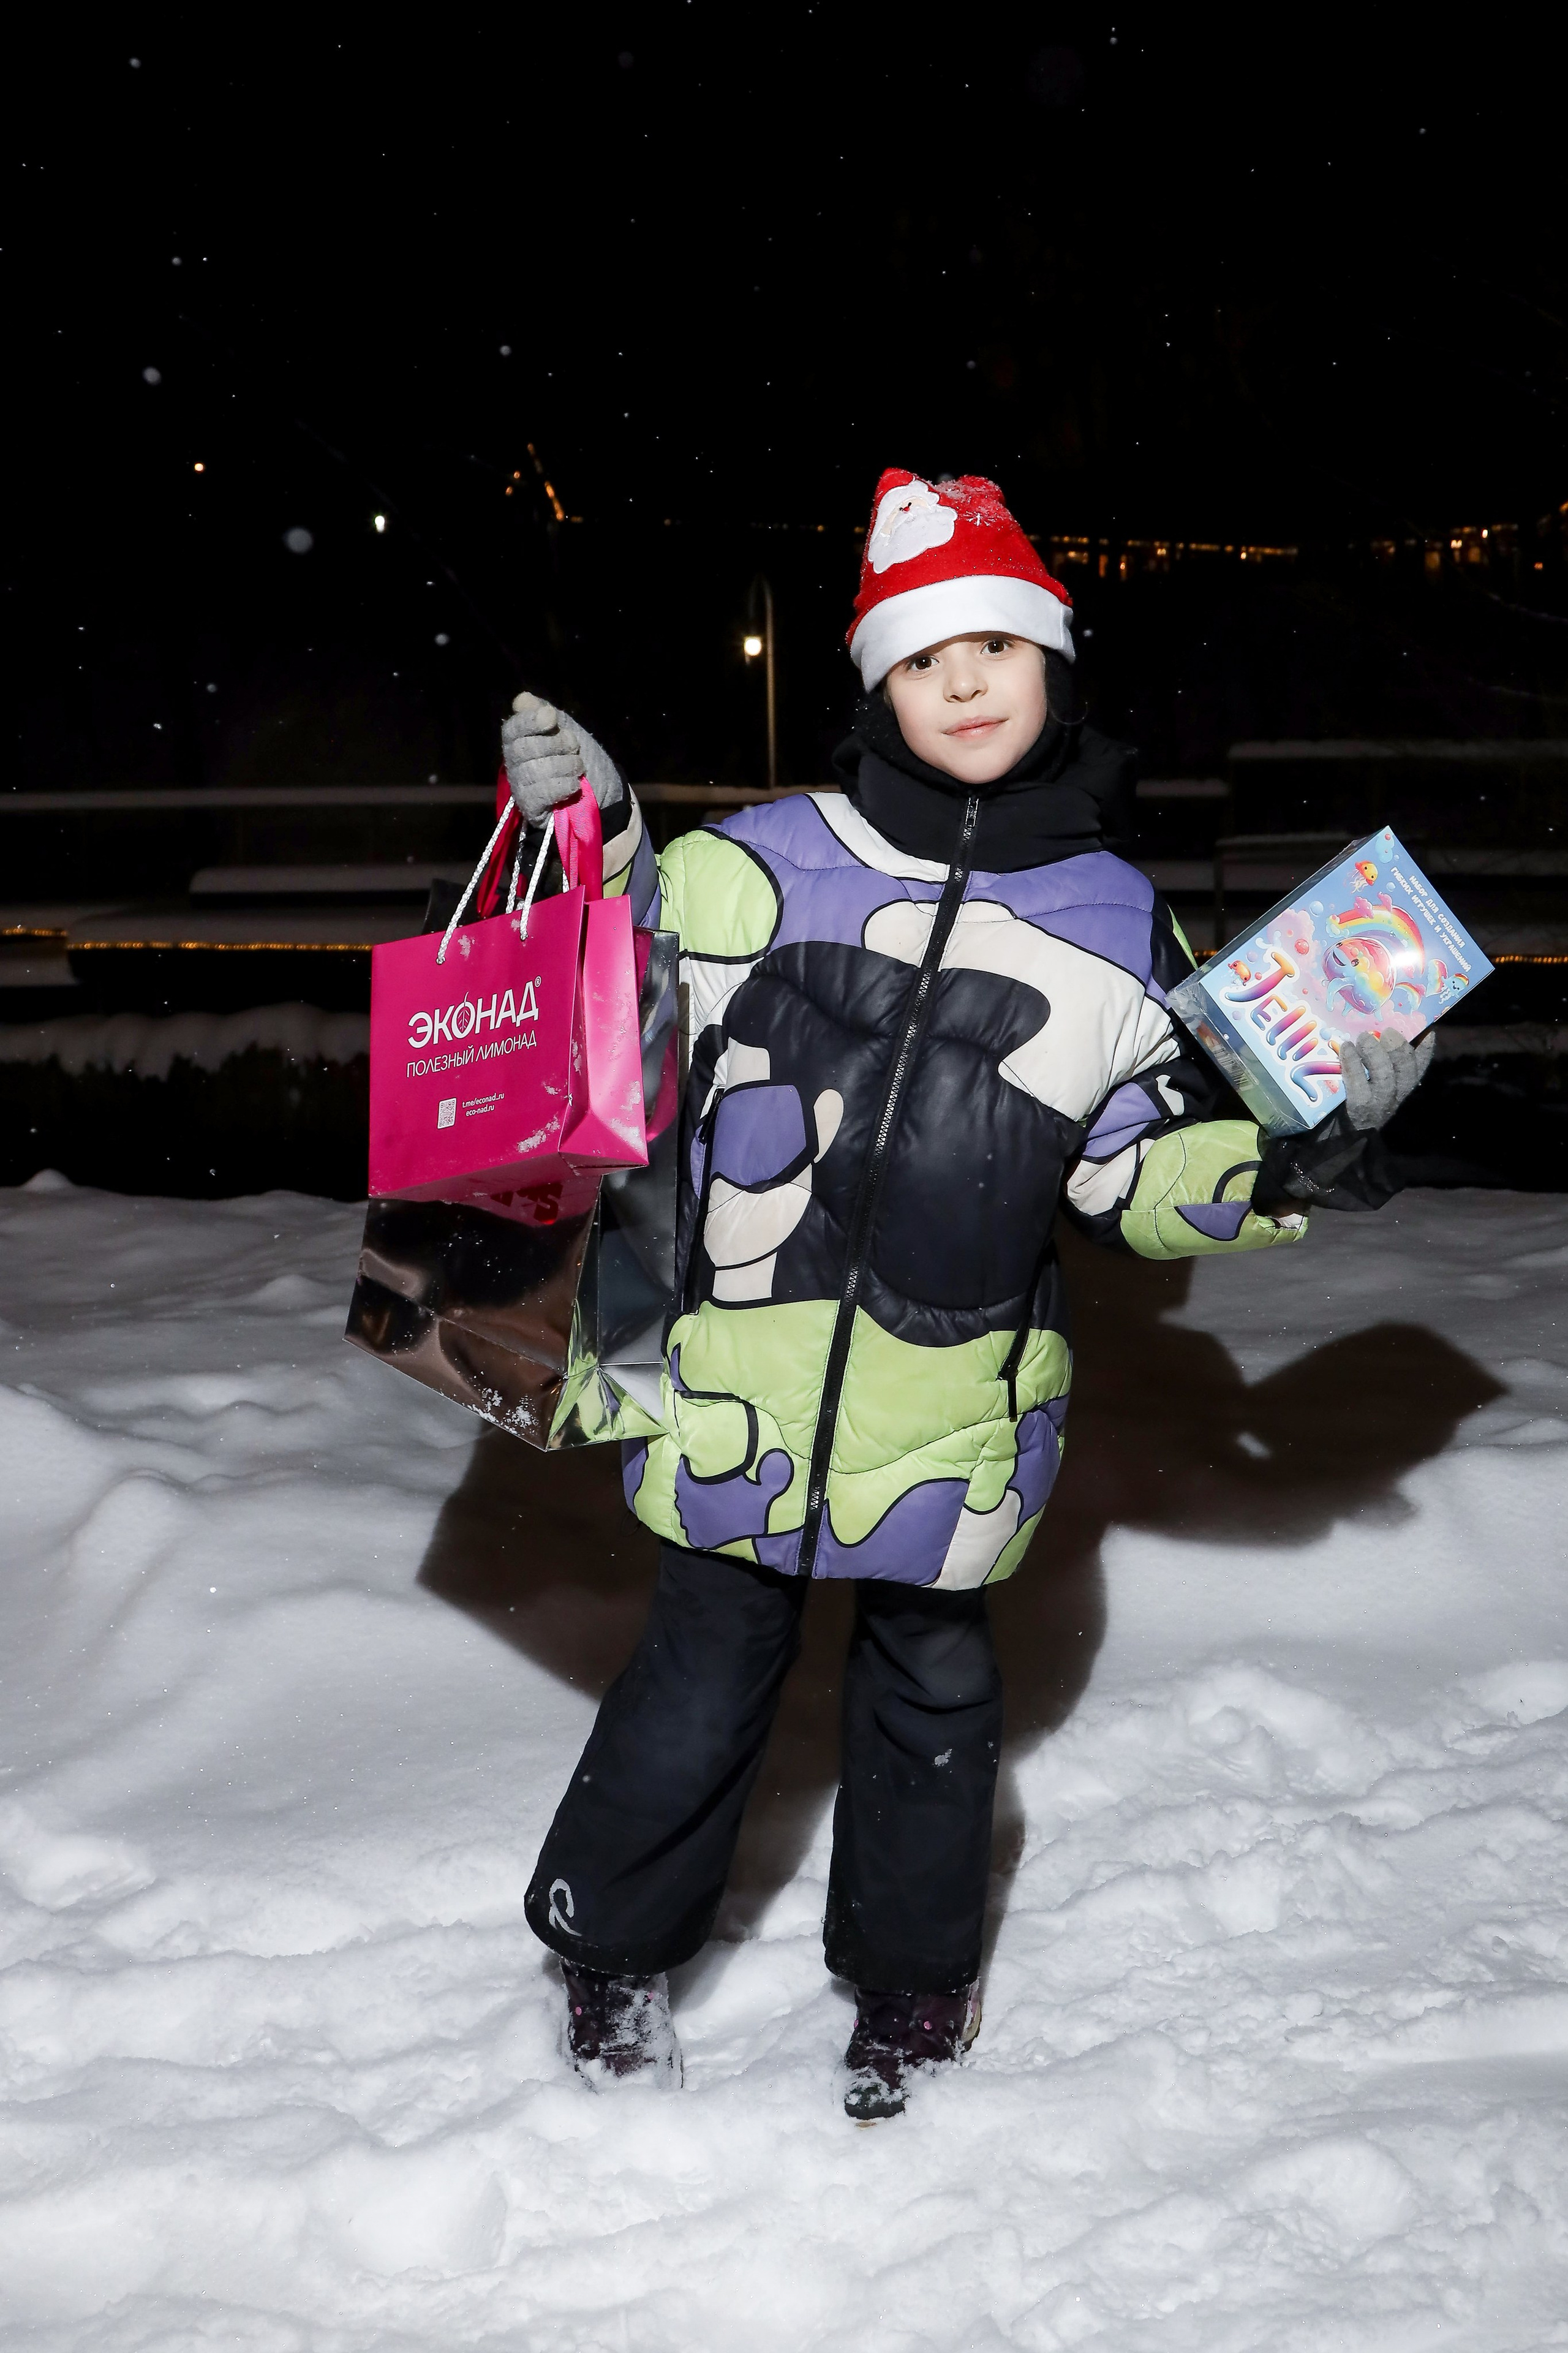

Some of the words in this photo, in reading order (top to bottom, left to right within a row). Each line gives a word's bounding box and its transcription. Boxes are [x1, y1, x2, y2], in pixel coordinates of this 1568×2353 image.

[1390, 866, 1414, 896] ГИБКИХ
[1411, 894, 1437, 926] ИГРУШЕК
[1434, 925, 1442, 934] И
[1439, 932, 1472, 973] УКРАШЕНИЙ
[1409, 875, 1428, 897] НАБОР
[1425, 898, 1439, 913] ДЛЯ
[1437, 913, 1466, 949] СОЗДАНИЯ
[407, 1044, 475, 1078] ПОЛЕЗНЫЙ
[475, 1029, 538, 1062] ЛИМОНАД
[462, 1092, 505, 1108] t.me/econad_ru
[466, 1104, 495, 1117] eco-nad.ru
